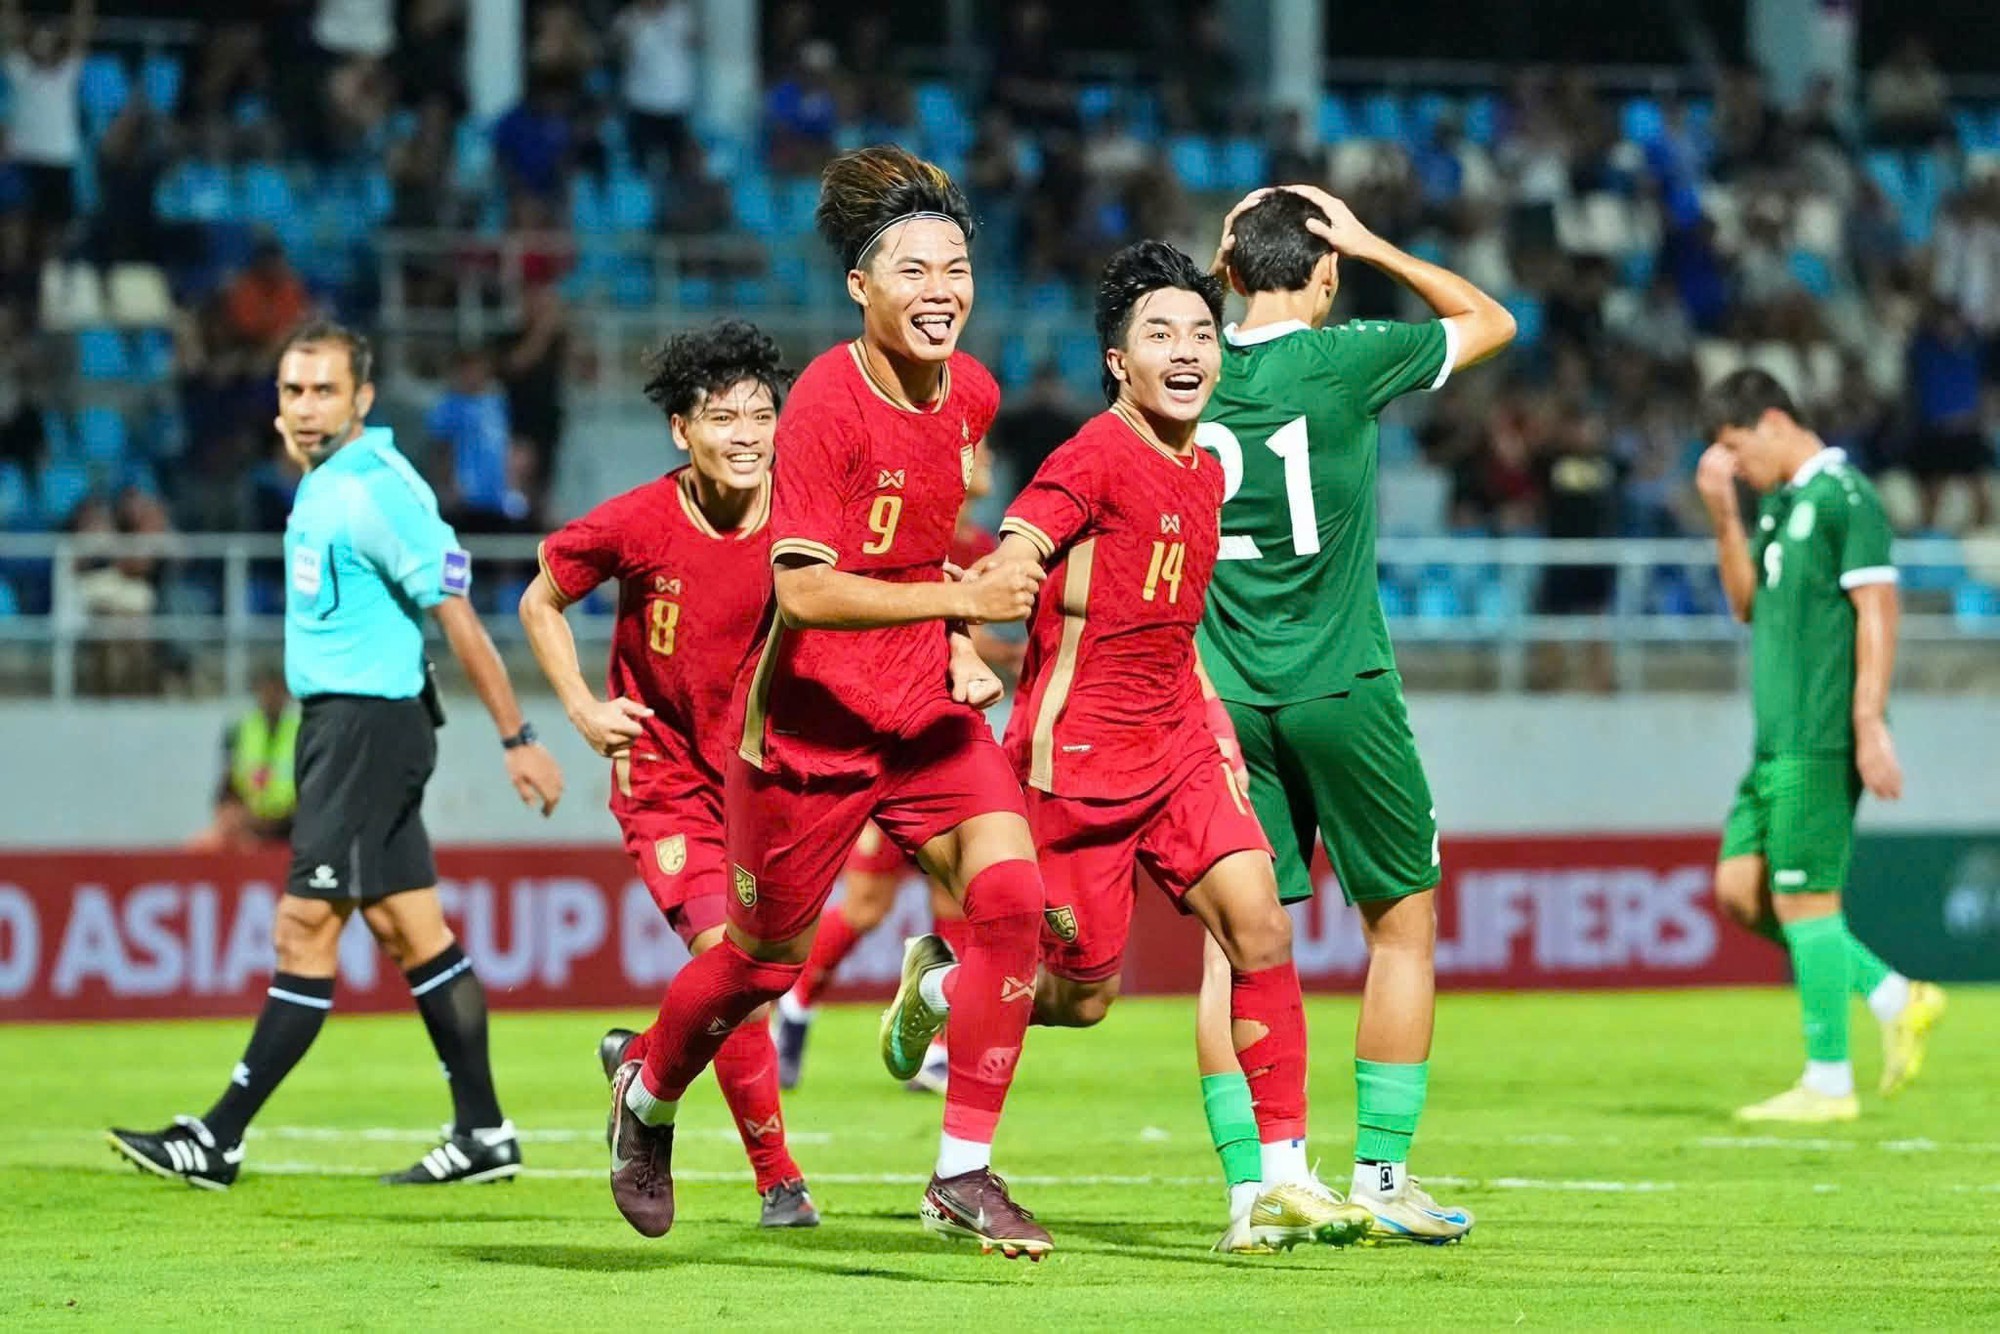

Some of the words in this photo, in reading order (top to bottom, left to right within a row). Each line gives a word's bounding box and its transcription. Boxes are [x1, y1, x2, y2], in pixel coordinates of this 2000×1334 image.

[1194, 415, 1321, 560] 21
[862, 495, 903, 555] 9
[1142, 541, 1186, 604] 14
[650, 599, 680, 656] 8
